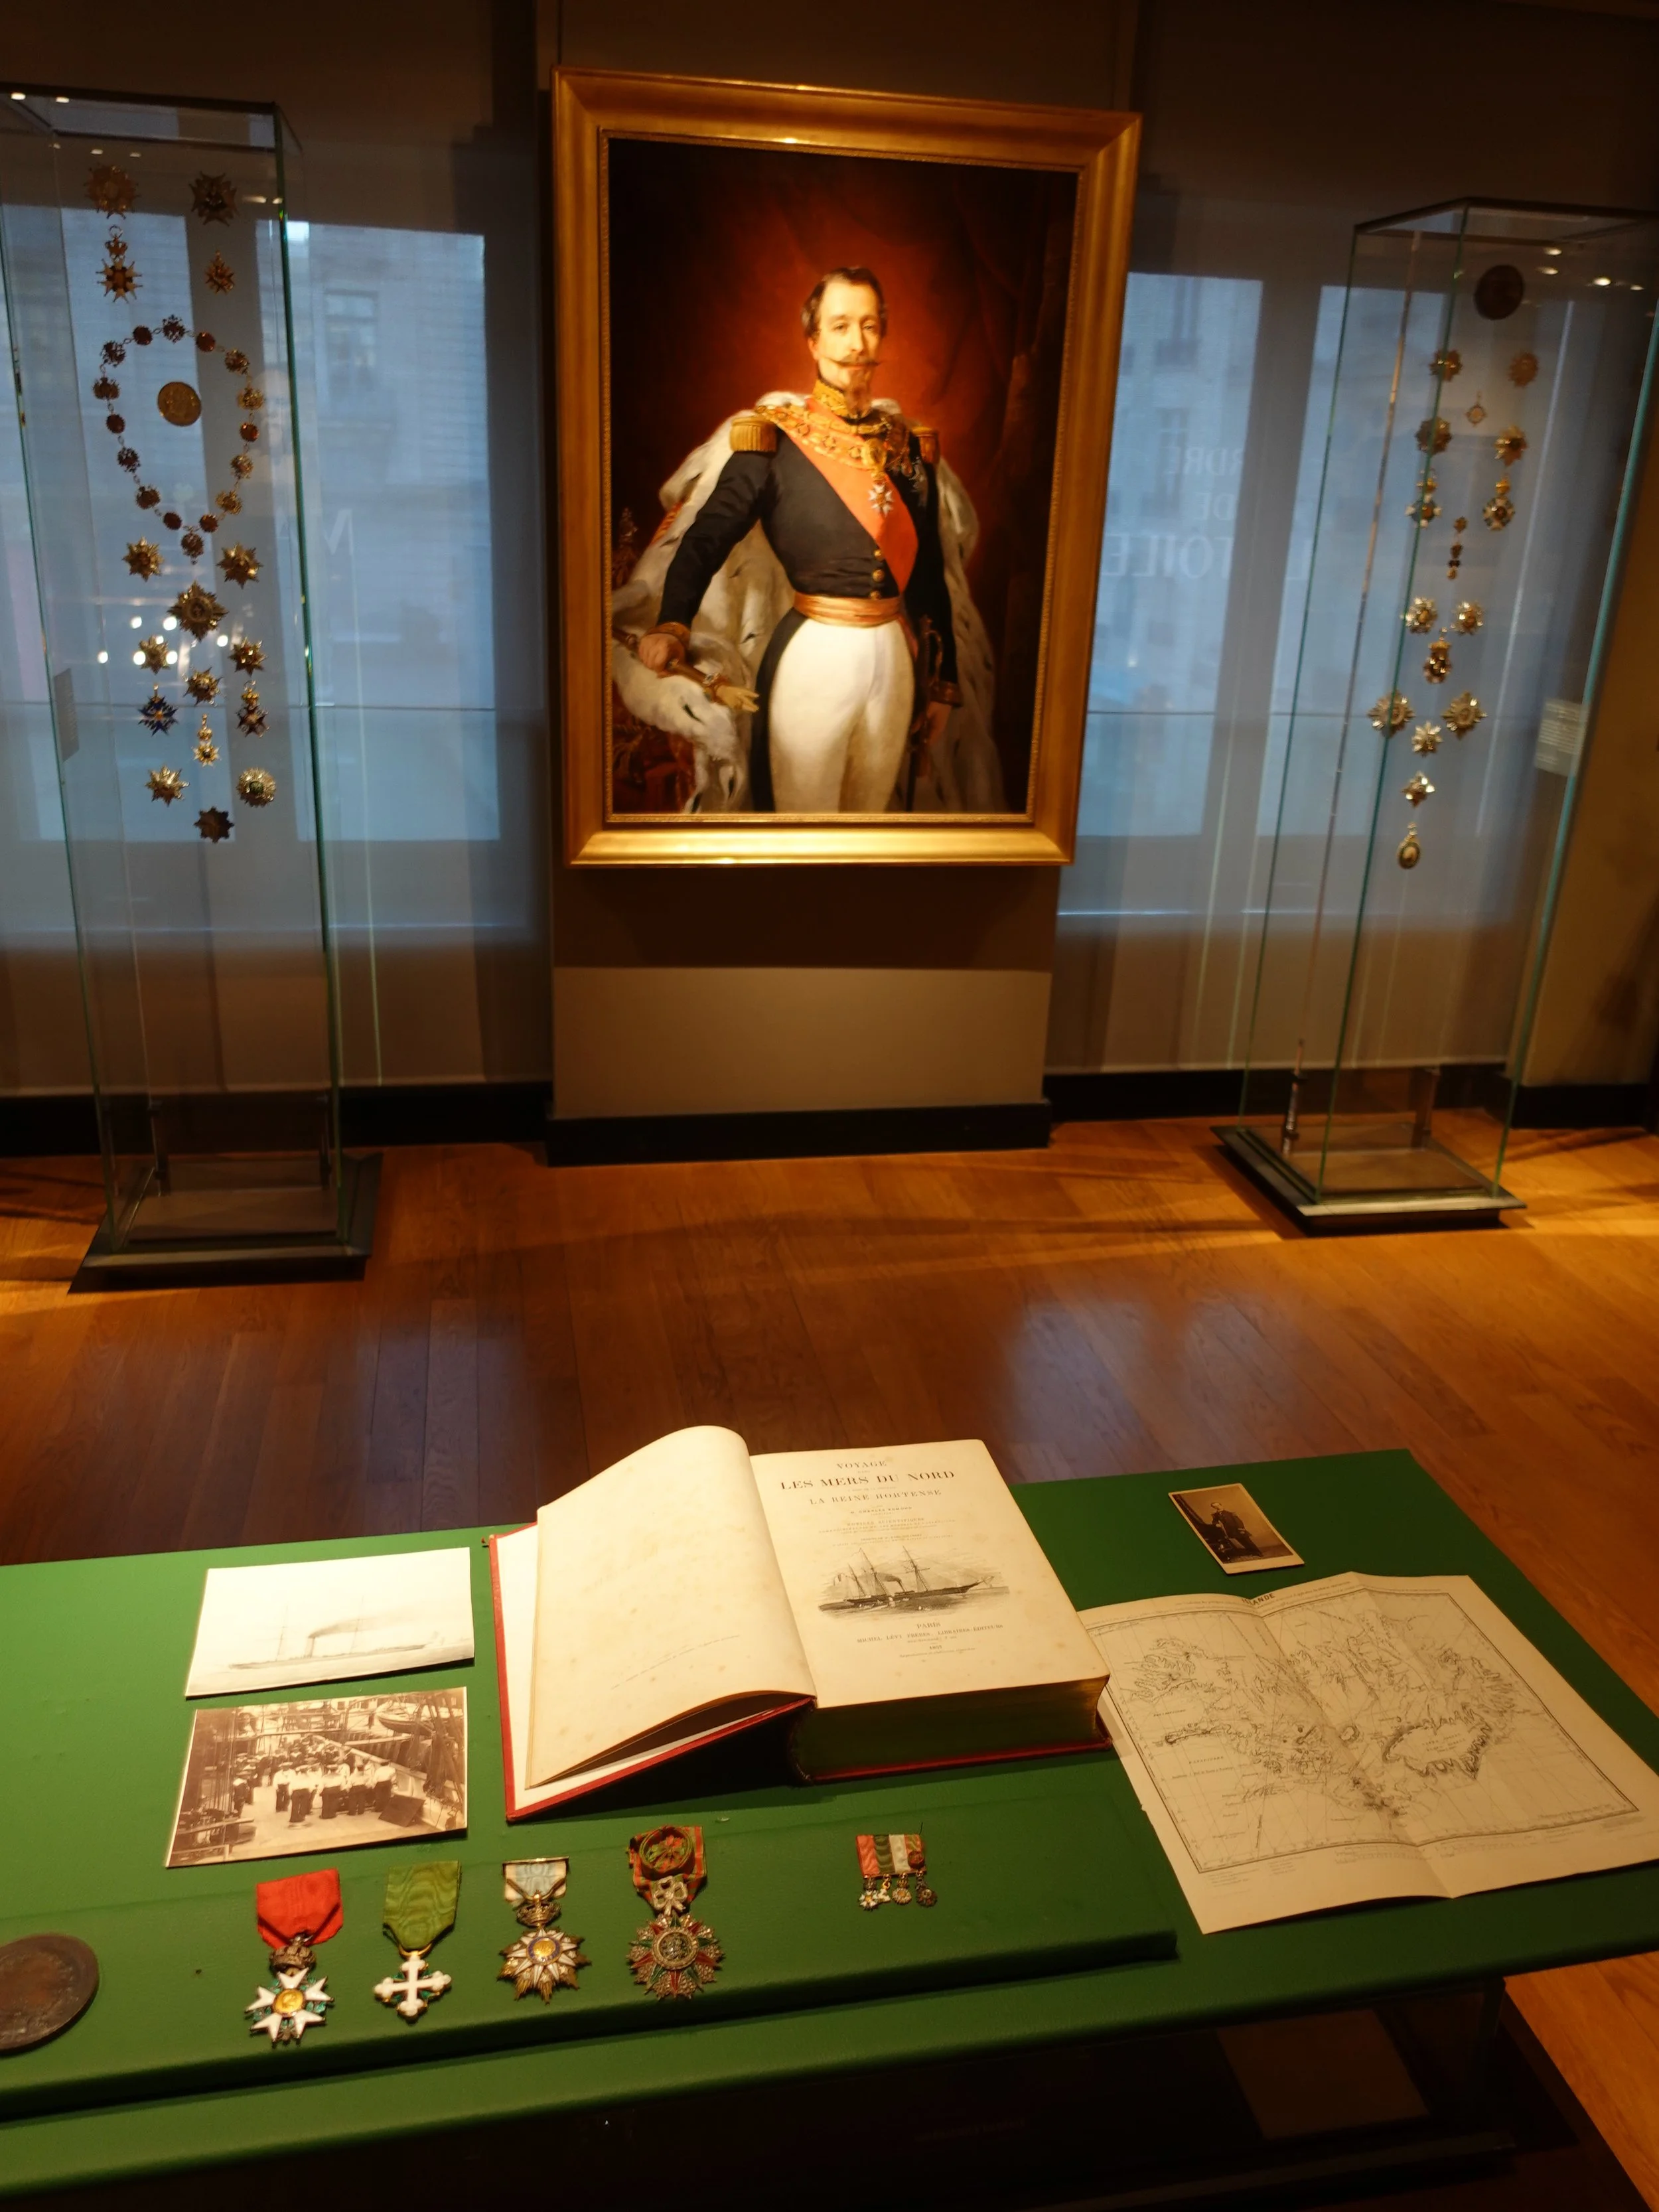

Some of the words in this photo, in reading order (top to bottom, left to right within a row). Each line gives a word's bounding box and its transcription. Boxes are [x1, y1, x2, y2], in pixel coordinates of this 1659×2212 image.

[836, 1460, 887, 1469] VOYAGE
[781, 1479, 814, 1490] LES
[820, 1476, 869, 1487] MERS
[877, 1474, 899, 1483] DU
[908, 1471, 955, 1481] NORD
[831, 1494, 870, 1503] REINE
[875, 1489, 942, 1500] HORTENSE
